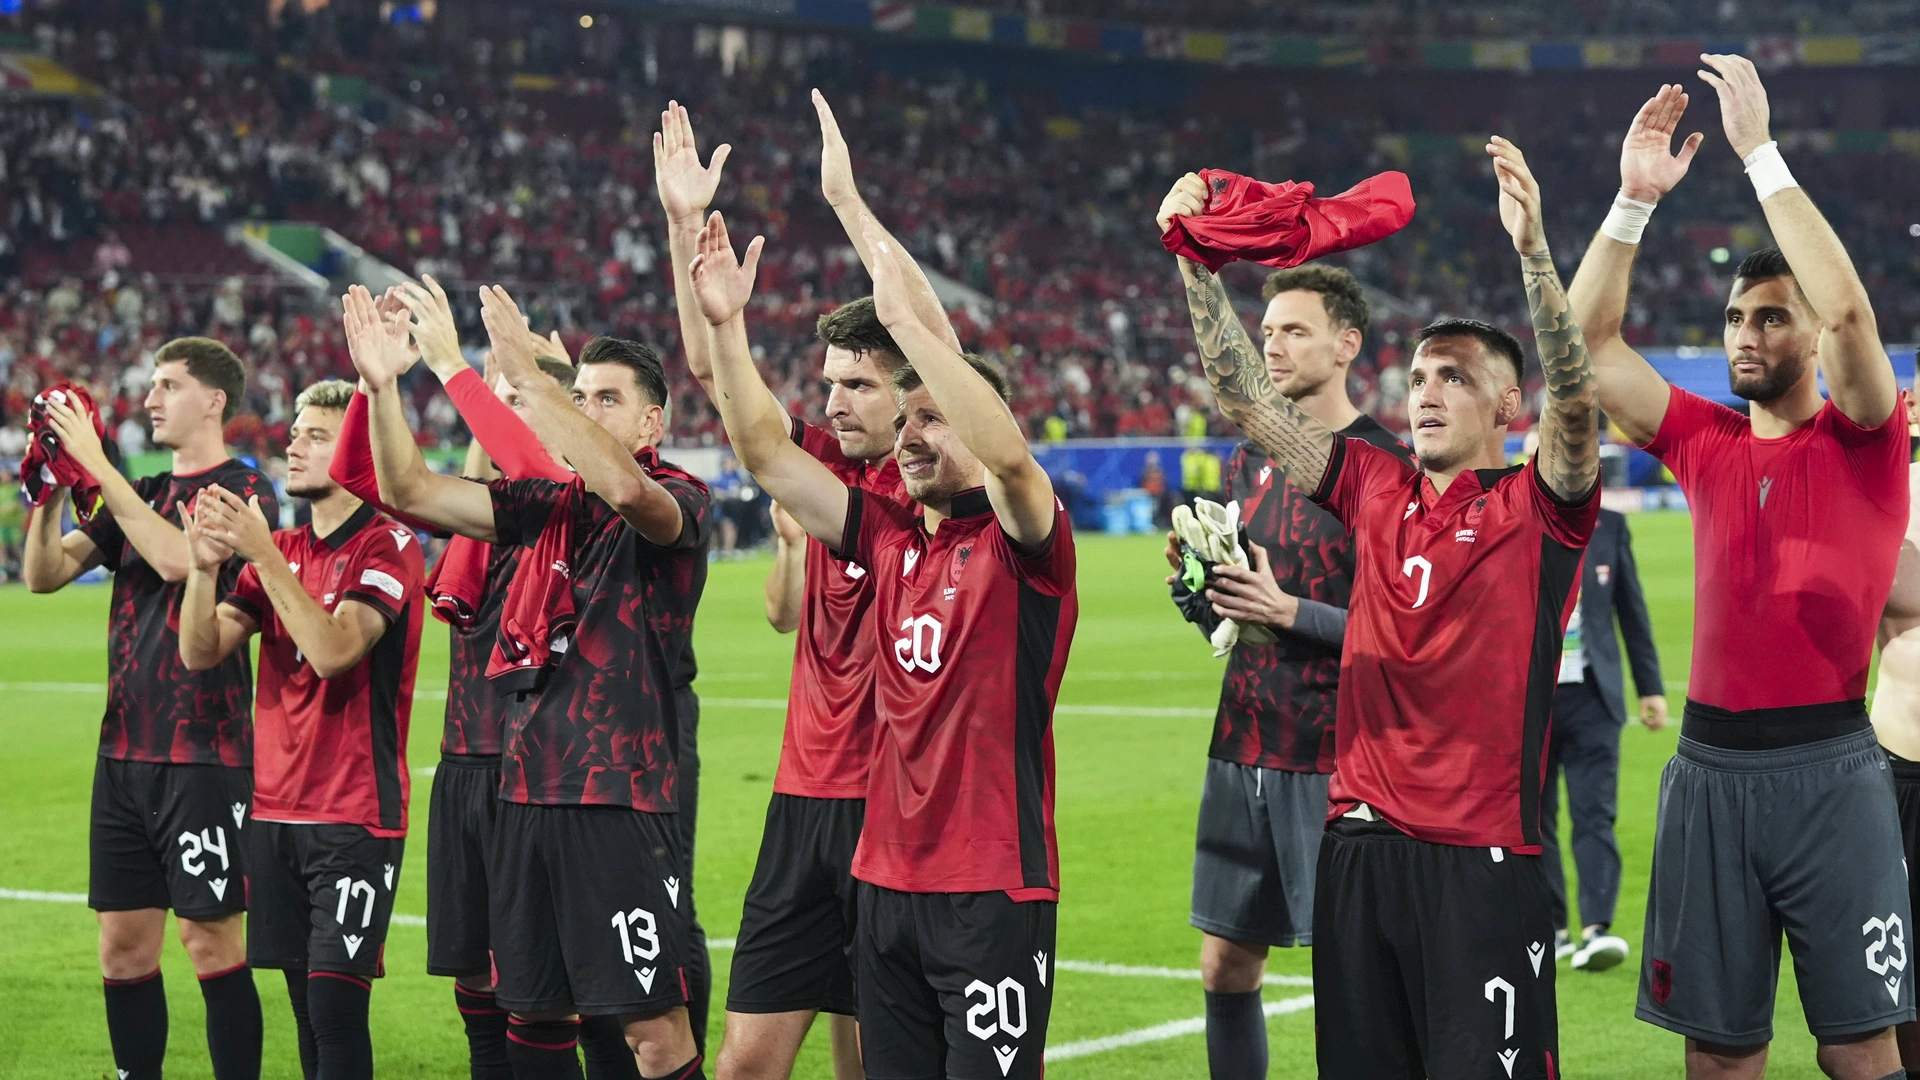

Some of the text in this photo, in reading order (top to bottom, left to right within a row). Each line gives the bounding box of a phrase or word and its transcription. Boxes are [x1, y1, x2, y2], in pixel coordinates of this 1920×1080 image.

[1403, 555, 1432, 609] 7
[895, 613, 942, 674] 20
[178, 826, 229, 876] 24
[335, 876, 376, 928] 17
[611, 907, 661, 964] 13
[1862, 912, 1907, 976] 23
[964, 976, 1027, 1041] 20
[1484, 976, 1515, 1040] 7
